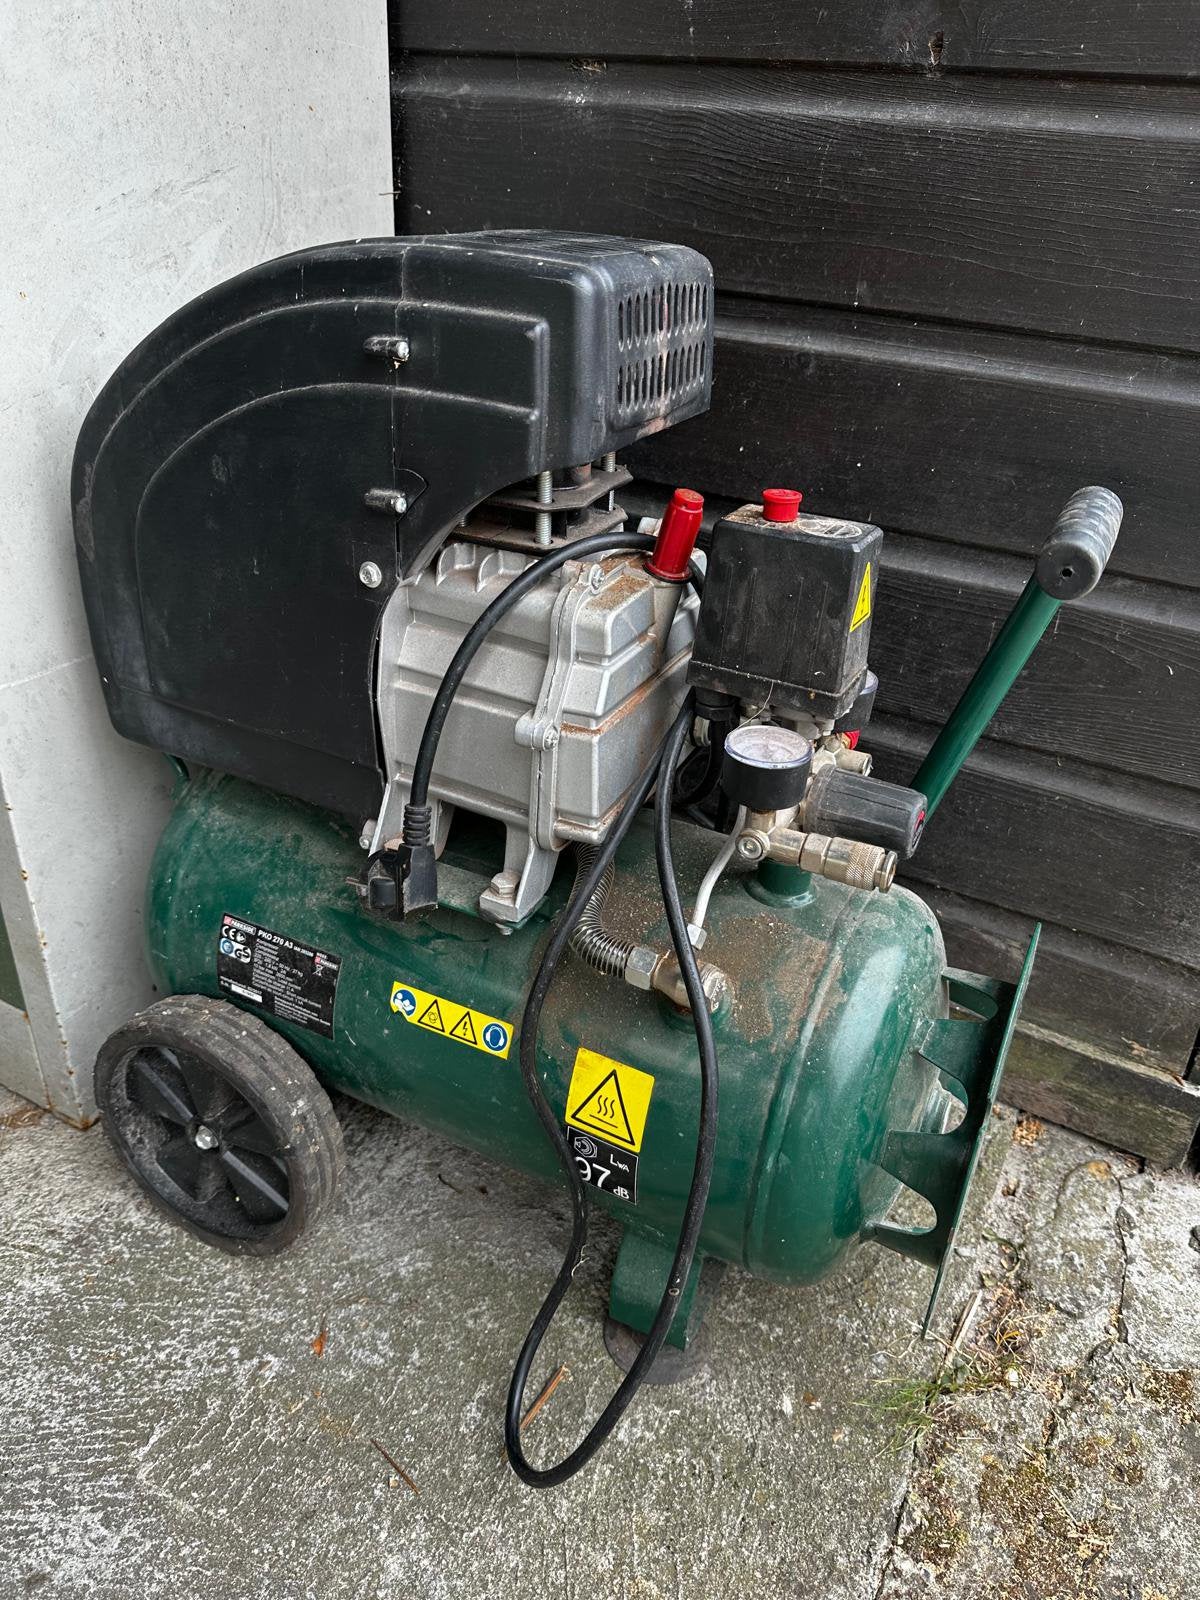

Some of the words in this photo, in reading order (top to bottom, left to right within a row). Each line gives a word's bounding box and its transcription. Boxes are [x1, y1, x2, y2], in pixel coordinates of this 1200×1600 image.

[258, 930, 272, 940] PKO
[273, 936, 284, 945] 270
[284, 940, 294, 949] A3
[234, 946, 250, 959] GS
[609, 1153, 630, 1173] LWA
[574, 1156, 611, 1188] 97
[613, 1185, 630, 1199] dB
